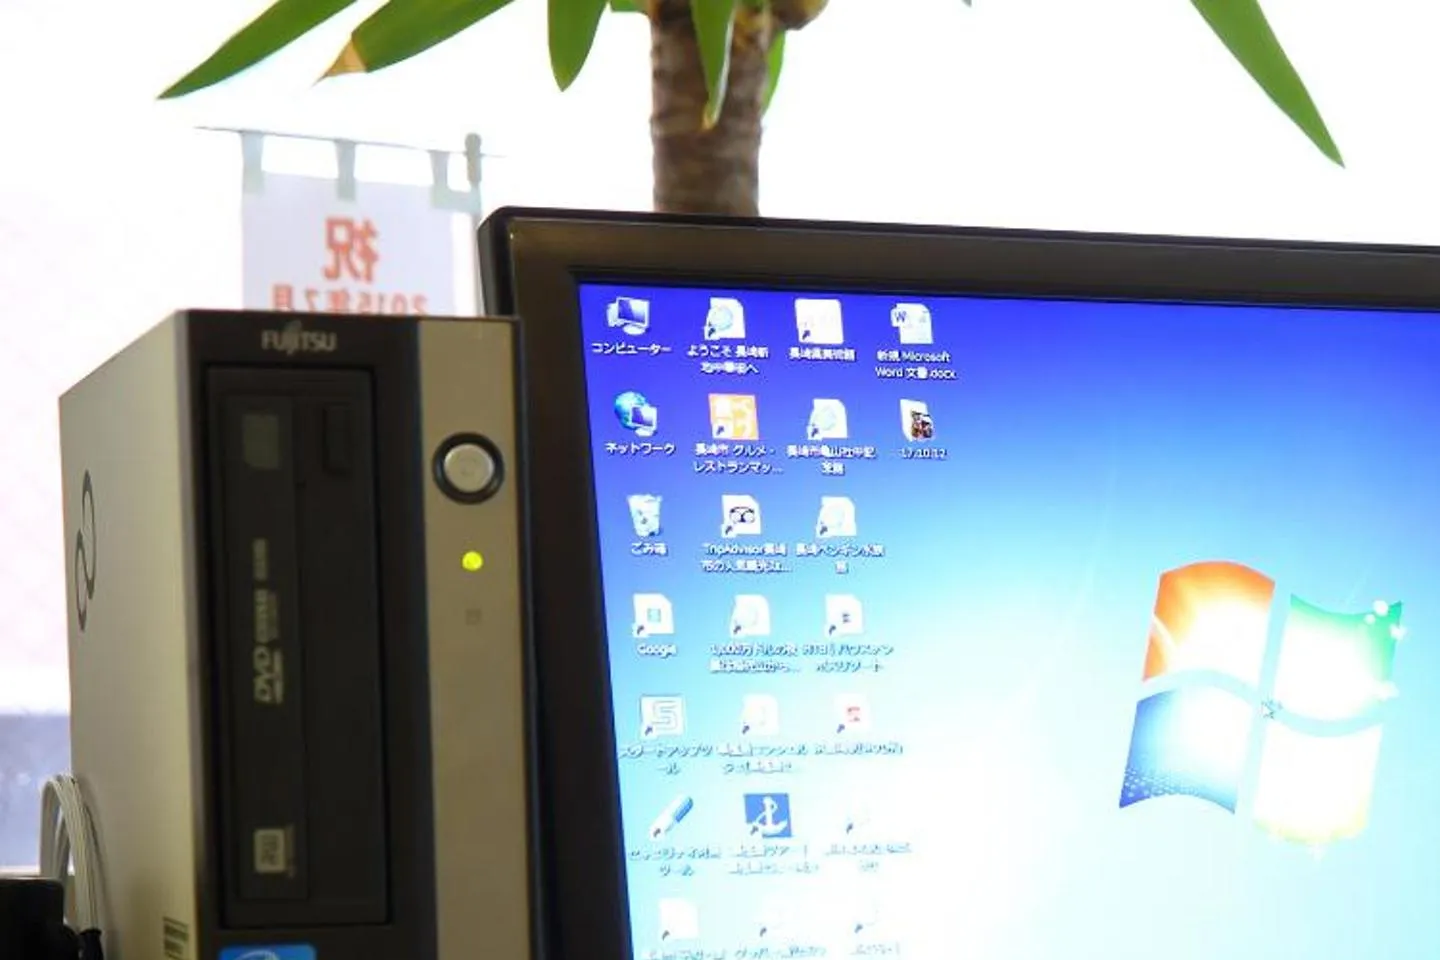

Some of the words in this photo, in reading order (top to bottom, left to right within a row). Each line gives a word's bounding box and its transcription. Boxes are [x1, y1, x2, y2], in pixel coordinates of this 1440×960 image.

[261, 329, 337, 353] FUJITSU
[591, 341, 672, 354] コンピューター
[902, 350, 951, 362] Microsoft
[875, 366, 904, 378] Word
[605, 442, 677, 455] ネットワーク
